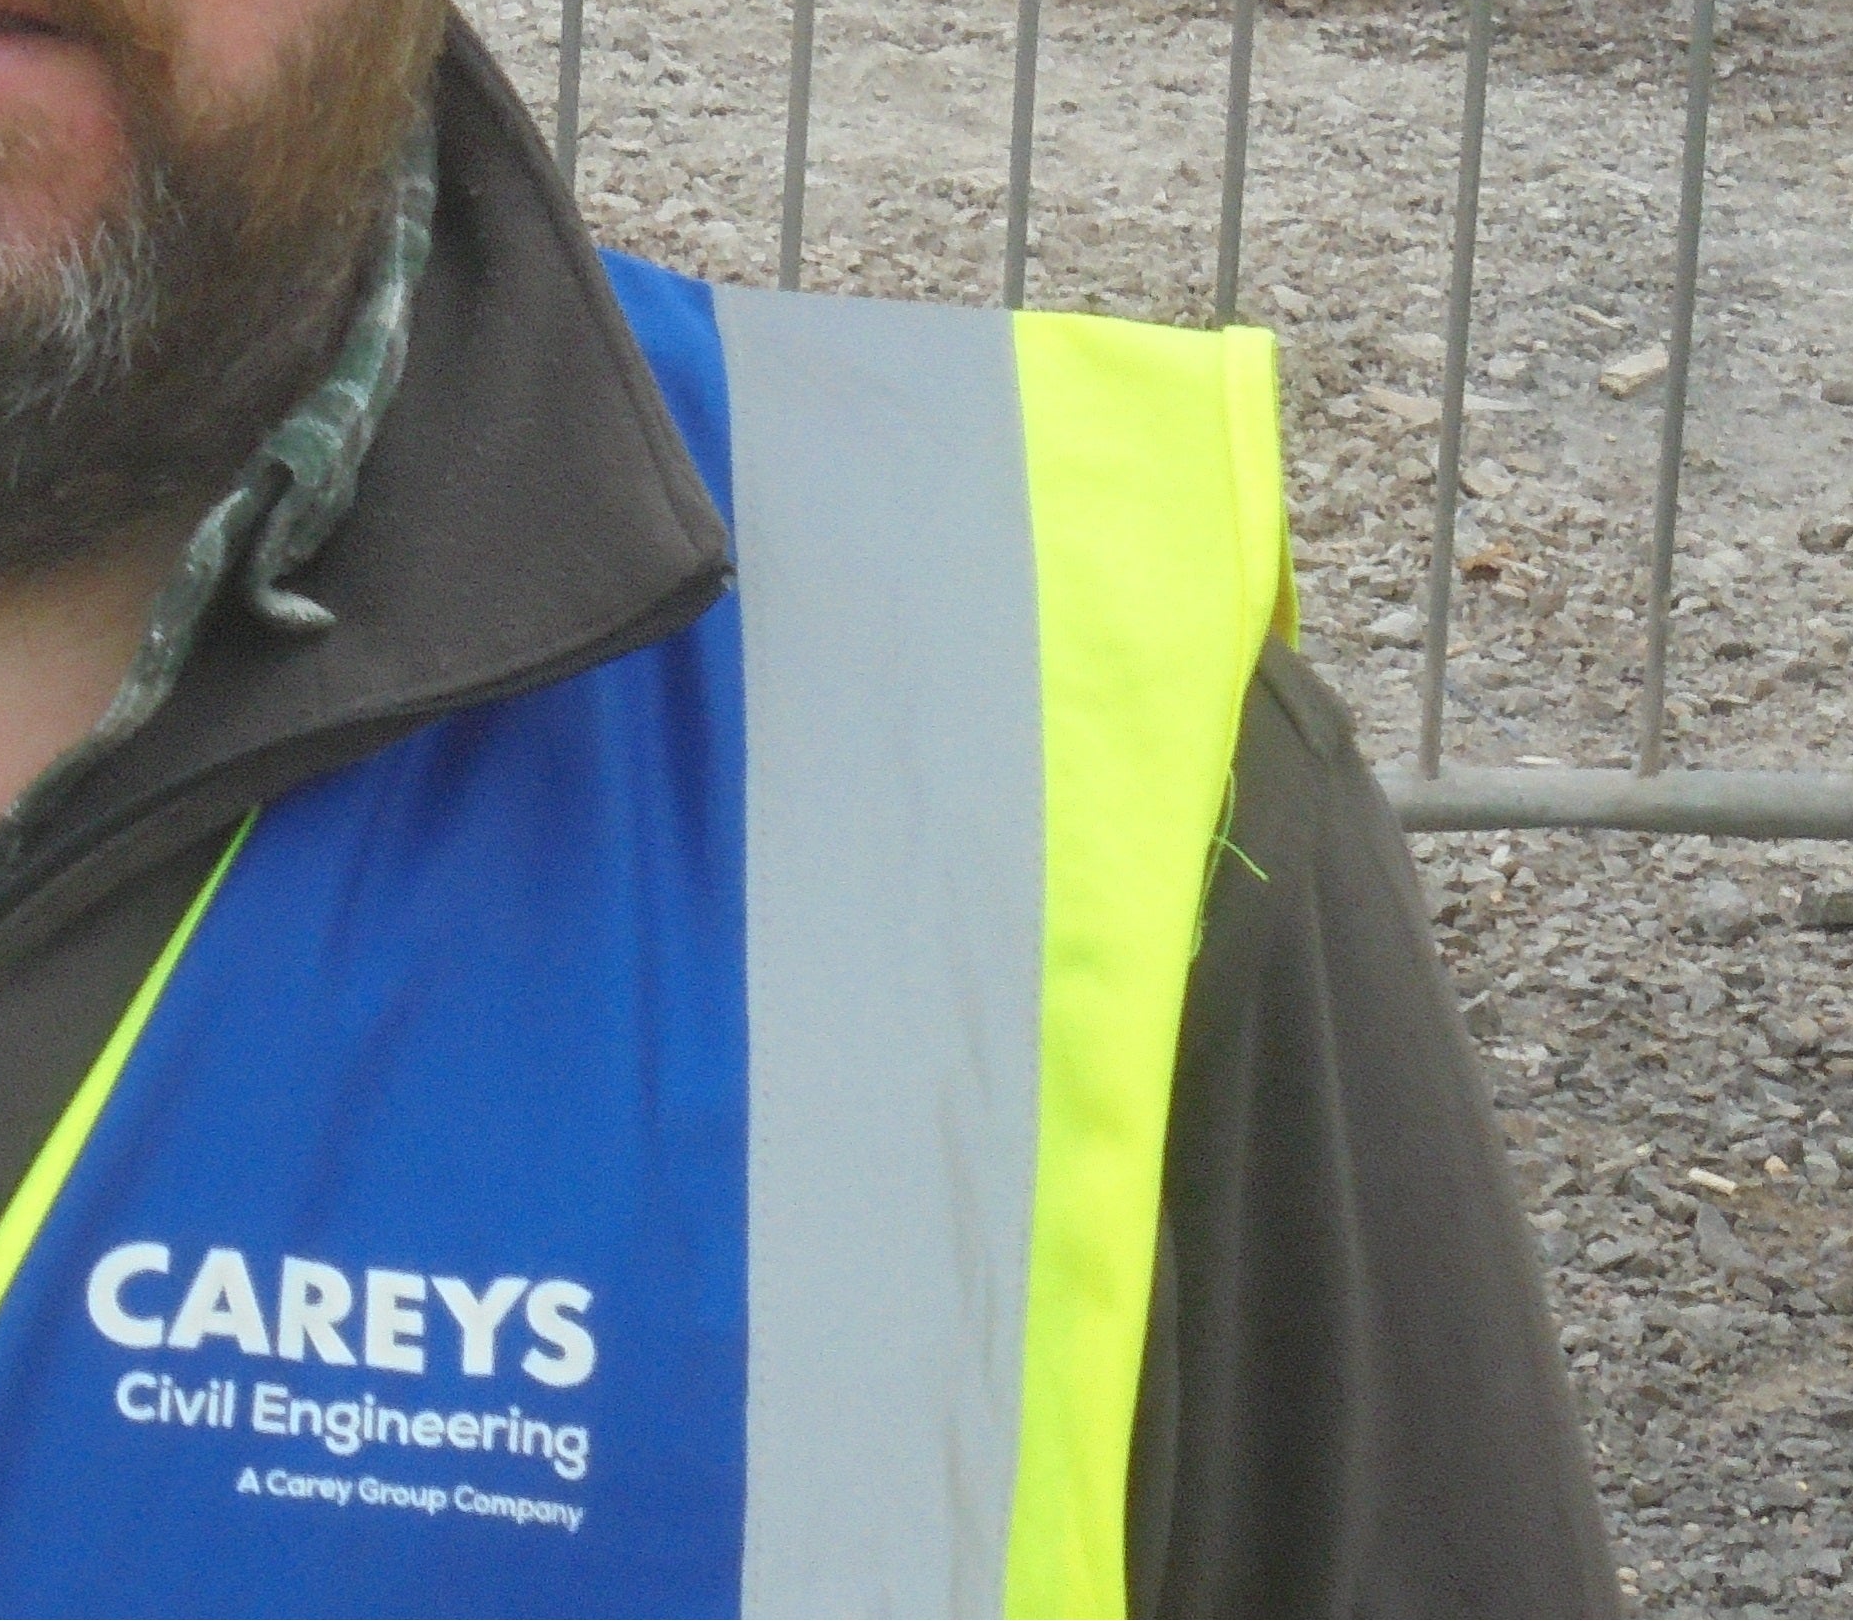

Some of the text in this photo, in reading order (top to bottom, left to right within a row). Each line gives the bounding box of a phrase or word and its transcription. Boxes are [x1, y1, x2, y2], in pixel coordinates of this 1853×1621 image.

[86, 1240, 596, 1388] CAREYS
[115, 1372, 589, 1479] Civil Engineering
[236, 1467, 583, 1533] A Carey Group Company
